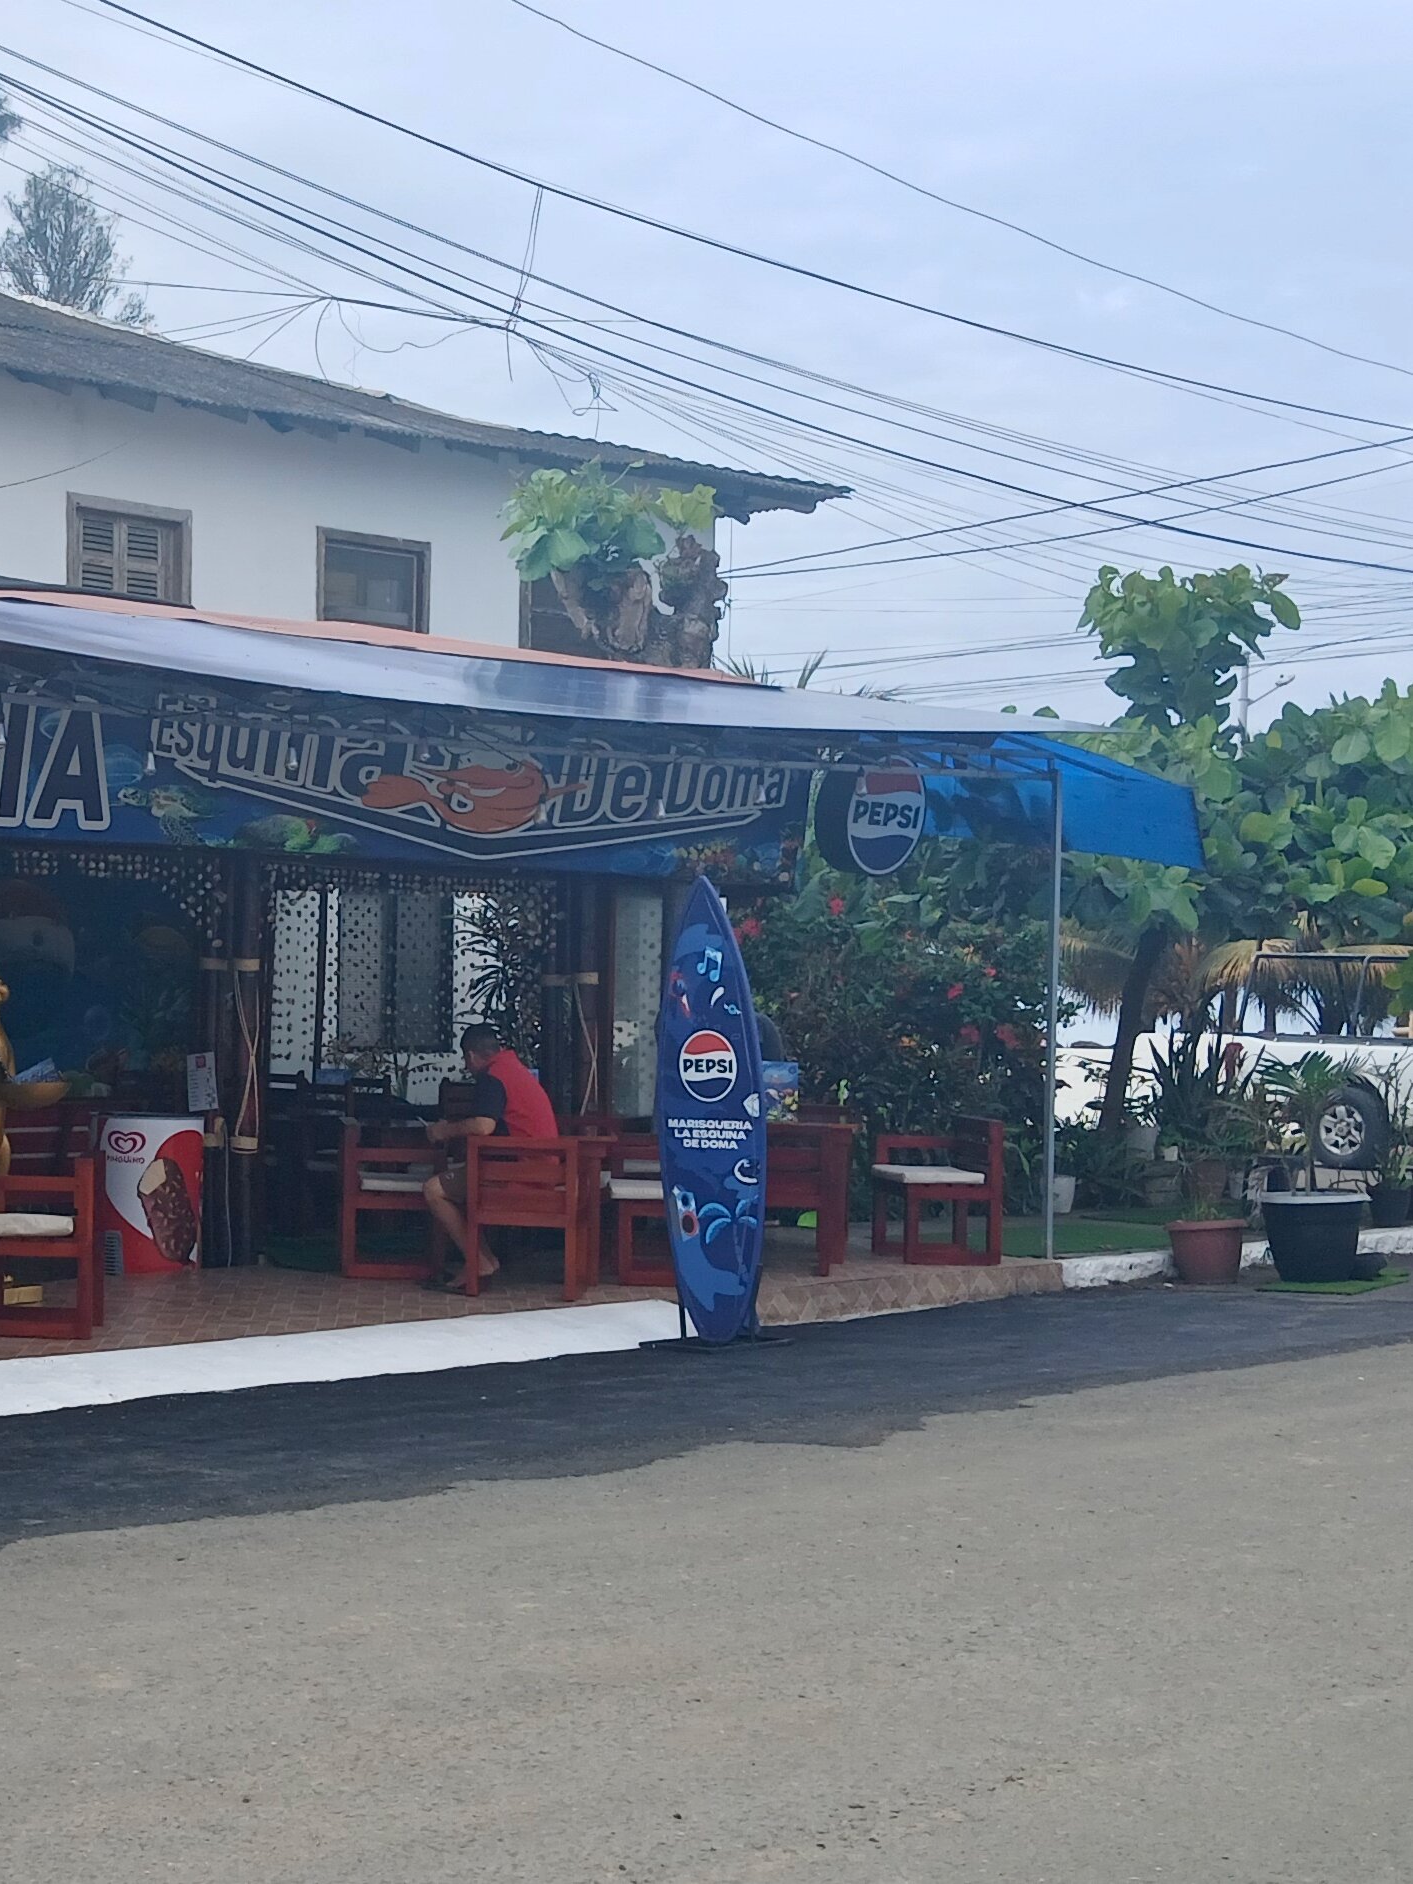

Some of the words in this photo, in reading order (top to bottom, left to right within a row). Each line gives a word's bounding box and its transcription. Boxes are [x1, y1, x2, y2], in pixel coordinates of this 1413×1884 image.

[551, 737, 653, 828] De
[852, 799, 921, 829] PEPSI
[682, 1058, 733, 1074] PEPSI
[667, 1118, 753, 1131] MARISQUERIA
[674, 1128, 691, 1138] LA
[692, 1130, 747, 1140] ESQUINA
[682, 1138, 700, 1149] DE
[701, 1139, 739, 1150] DOMA
